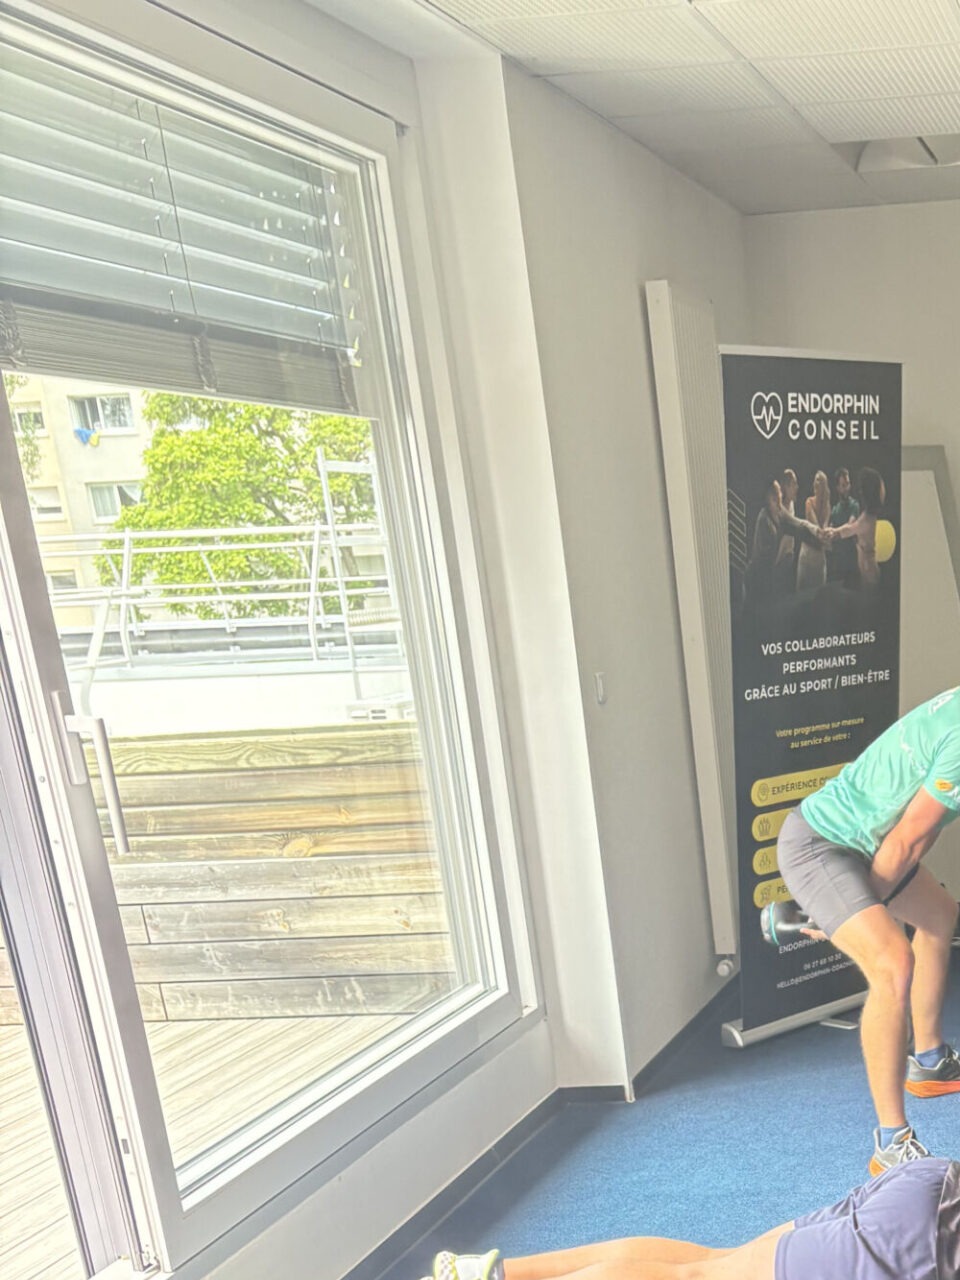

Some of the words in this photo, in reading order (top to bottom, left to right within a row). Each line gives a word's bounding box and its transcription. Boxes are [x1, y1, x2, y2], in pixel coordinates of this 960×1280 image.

[787, 392, 880, 415] ENDORPHIN
[788, 419, 879, 440] CONSEIL
[761, 642, 783, 656] VOS
[785, 631, 876, 652] COLLABORATEURS
[782, 654, 857, 674] PERFORMANTS
[744, 684, 780, 701] GRÂCE
[782, 683, 797, 696] AU
[800, 678, 833, 693] SPORT
[834, 675, 839, 690] /
[841, 669, 891, 687] BIEN-ÊTRE
[793, 723, 830, 737] programme
[831, 721, 841, 729] sur
[841, 717, 864, 727] mesure
[800, 737, 822, 747] service
[771, 778, 817, 795] EXPÉRIENCE
